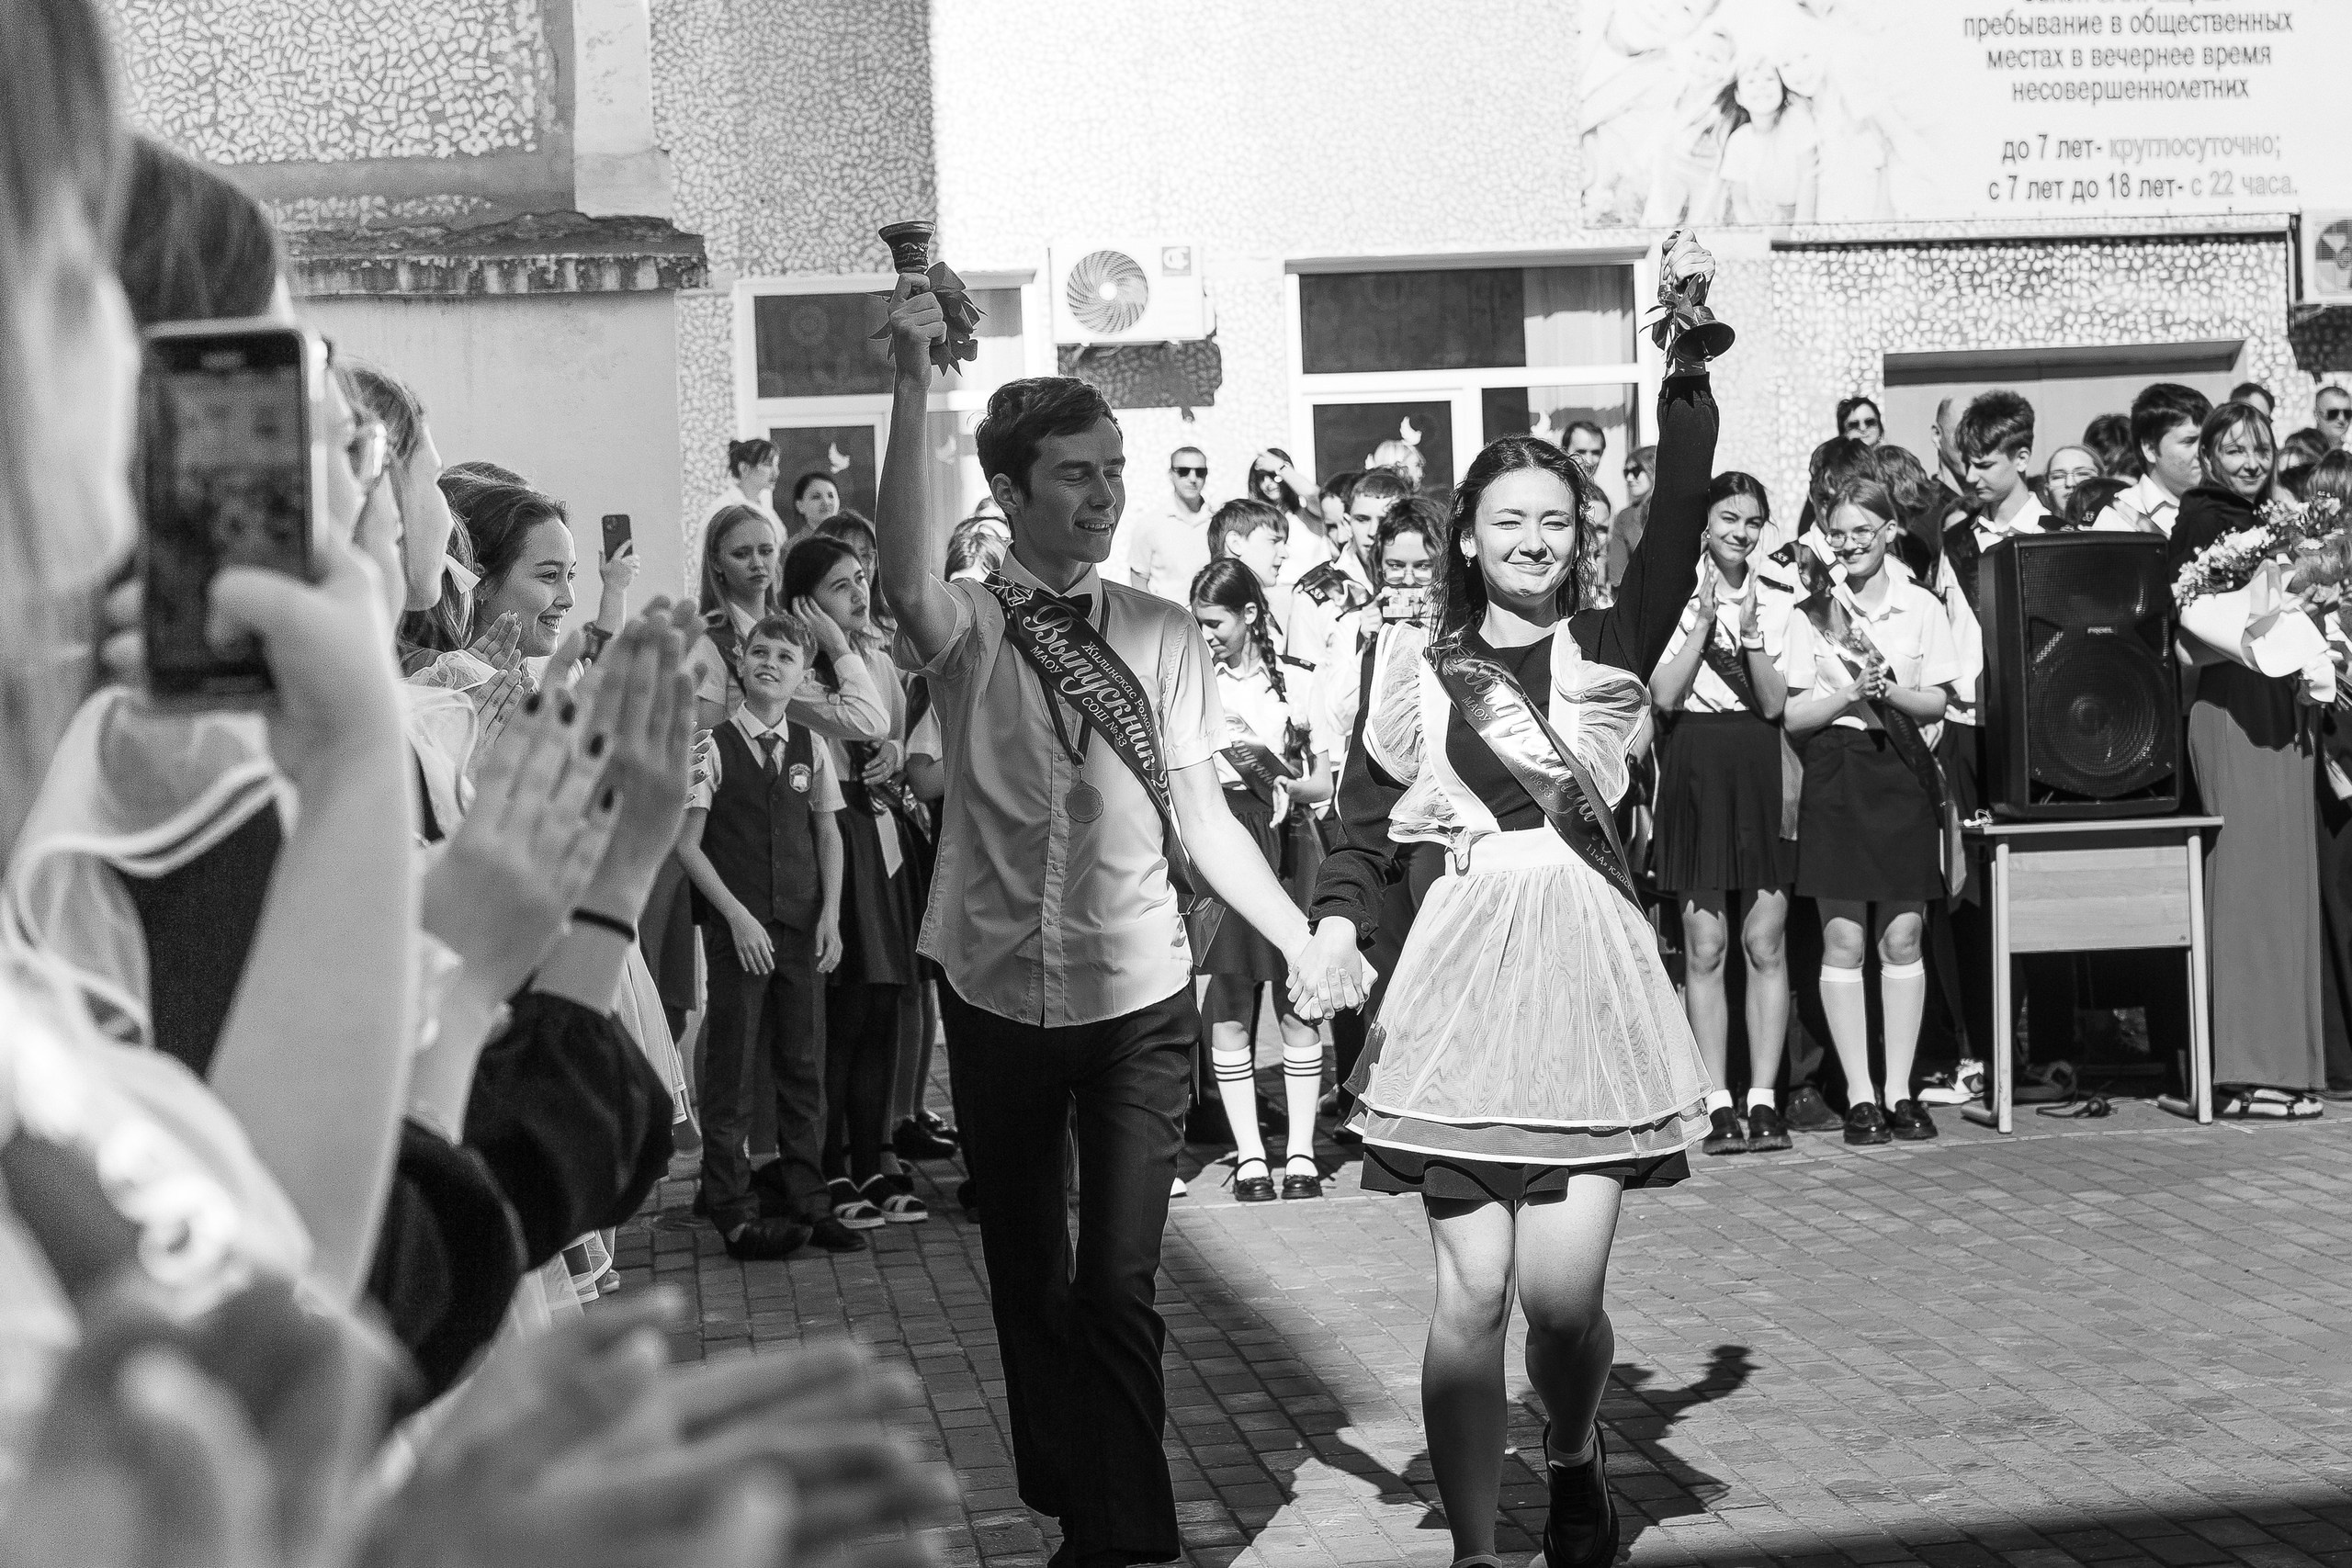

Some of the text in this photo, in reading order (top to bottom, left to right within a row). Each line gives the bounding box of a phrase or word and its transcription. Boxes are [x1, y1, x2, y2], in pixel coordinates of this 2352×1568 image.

[1964, 7, 2293, 42] пребывание в общественных
[1987, 46, 2271, 73] местах в вечернее время
[2013, 79, 2249, 106] несовершеннолетних
[2002, 141, 2030, 164] до
[2038, 134, 2048, 159] 7
[2110, 135, 2280, 166] круглосуточно;
[1989, 182, 1999, 200] с
[2008, 175, 2018, 200] 7
[2028, 181, 2064, 199] лет
[2072, 180, 2098, 204] до
[2109, 173, 2131, 197] 18
[2191, 177, 2202, 196] с
[2210, 171, 2233, 196] 22
[1022, 604, 1156, 772] Выпускник
[1030, 645, 1128, 748] МАОУ СОШ №33
[1081, 641, 1154, 738] Жилинскас Роман
[1461, 695, 1492, 722] МАОУ
